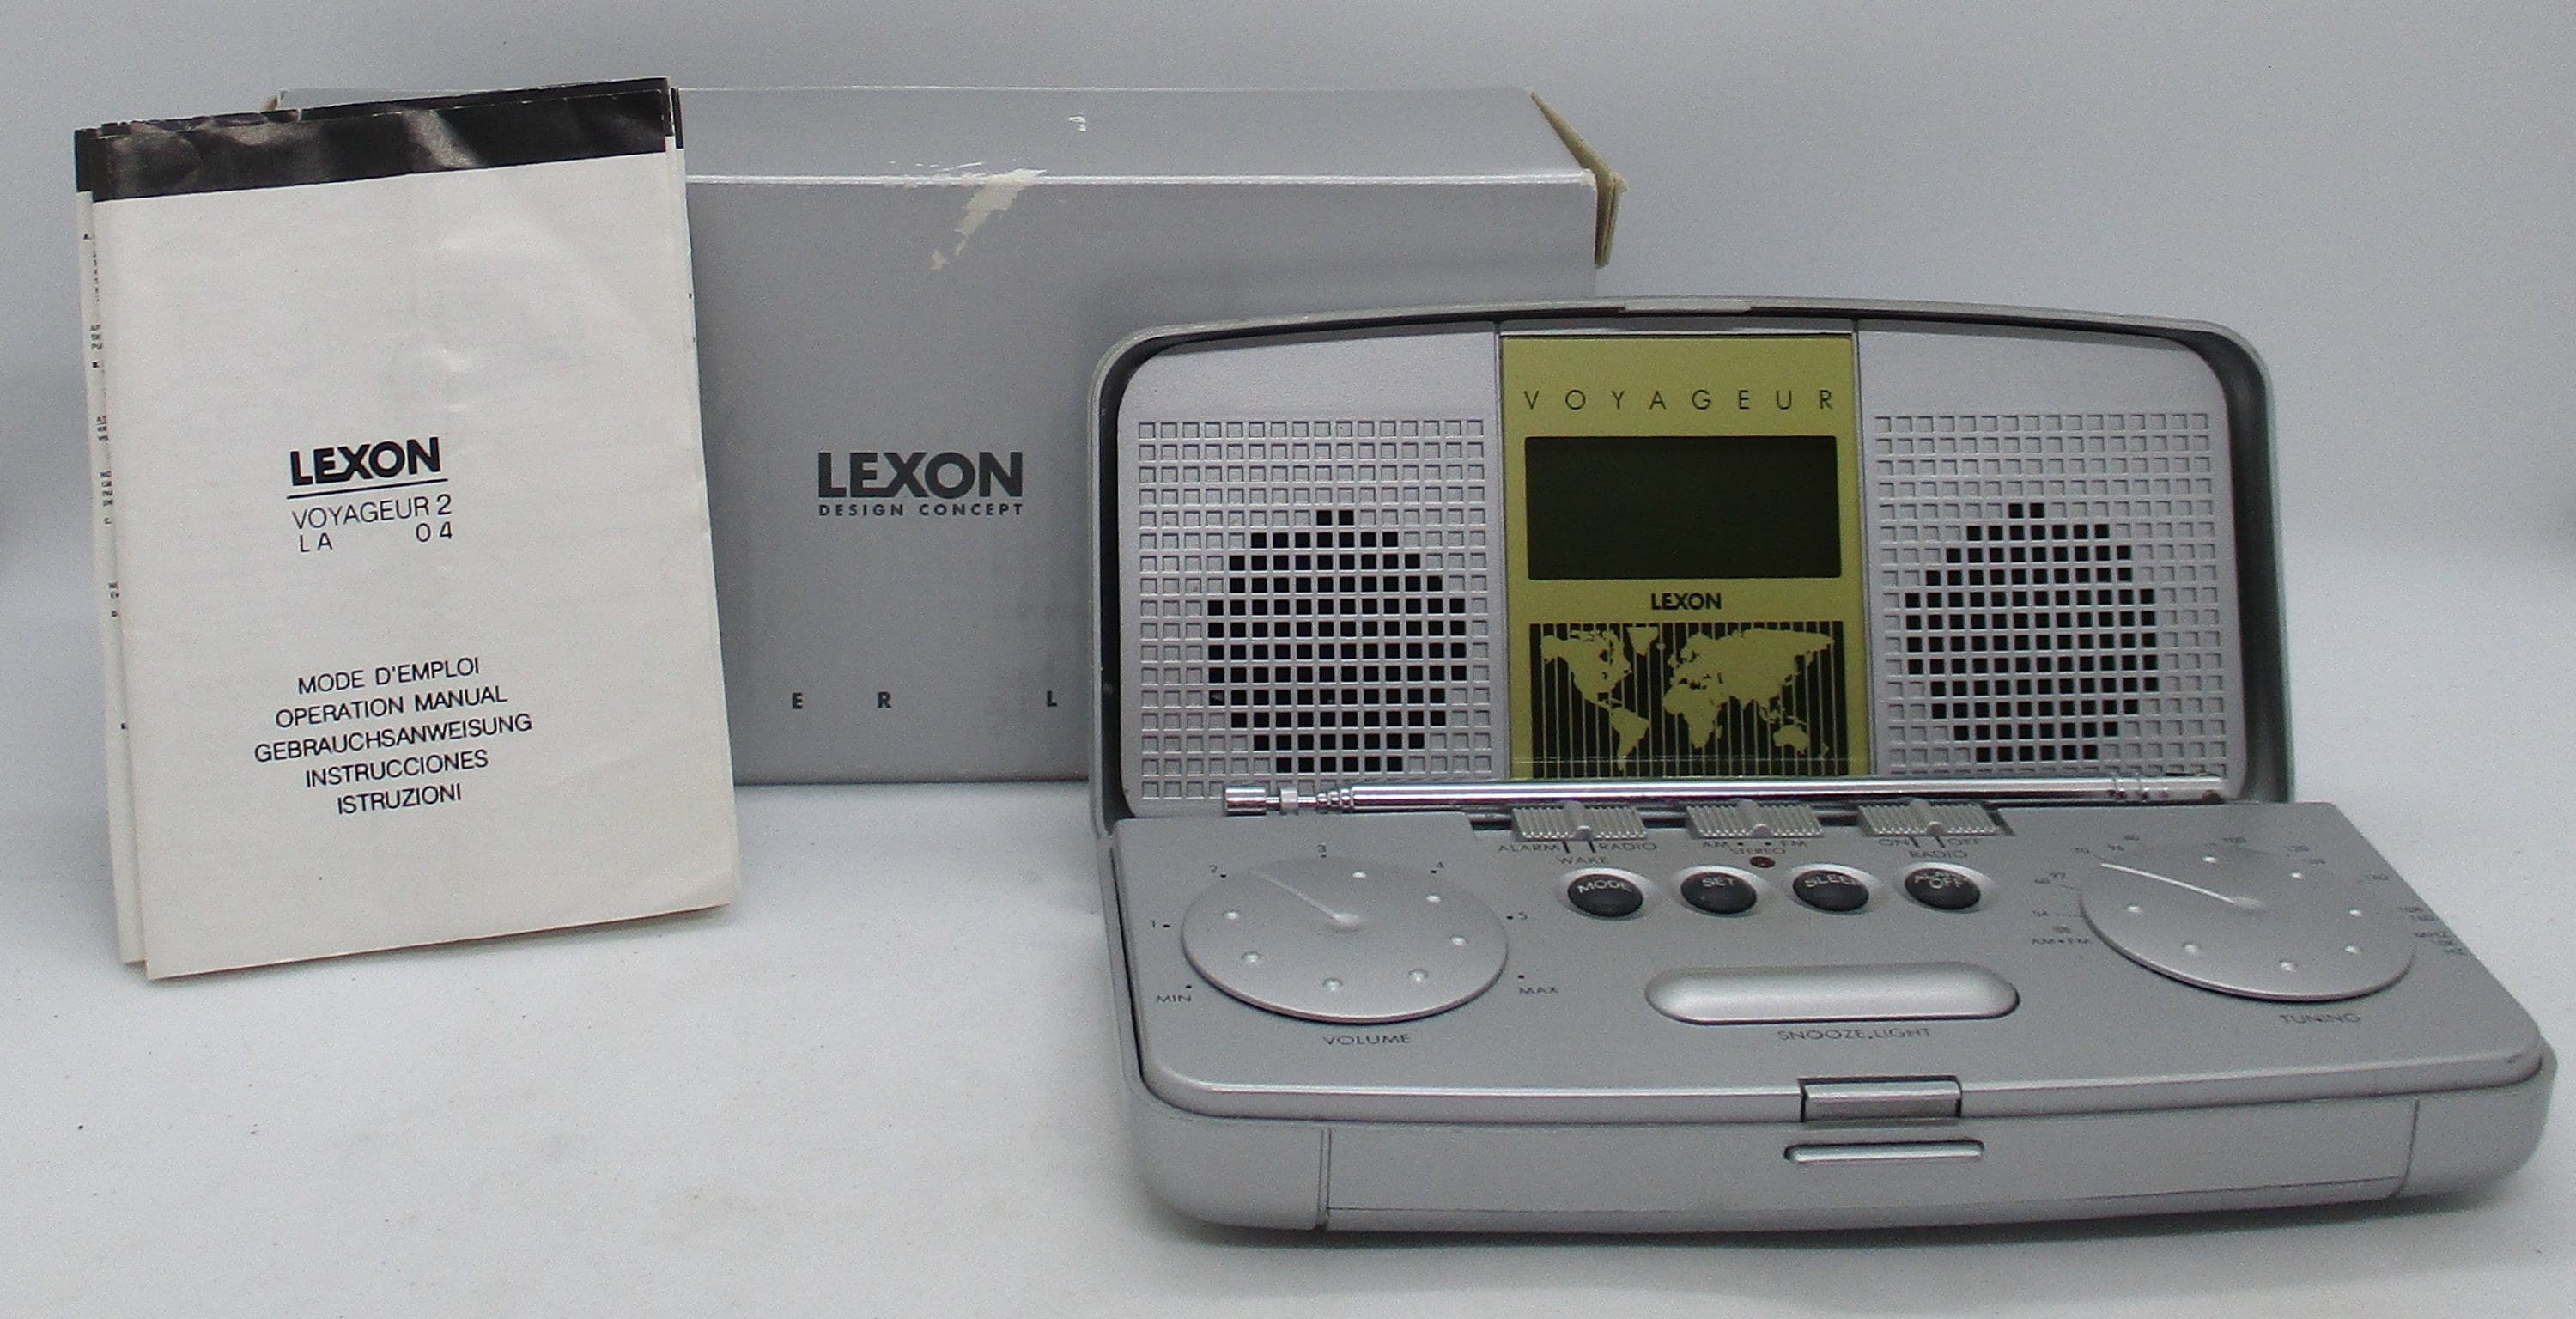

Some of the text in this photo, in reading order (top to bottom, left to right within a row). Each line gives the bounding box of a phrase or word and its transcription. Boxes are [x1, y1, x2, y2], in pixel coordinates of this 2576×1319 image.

[1522, 390, 1834, 411] VOYAGEUR
[289, 436, 441, 487] LEXON
[817, 451, 1024, 499] LEXON
[291, 493, 453, 530] VOYAGEUR 2
[818, 502, 1024, 517] DESIGN CONCEPT
[1649, 592, 1722, 611] LEXON
[297, 656, 481, 695] MODE D'EMPLOI
[275, 684, 508, 729] OPERATION MANUAL
[254, 713, 532, 763] GEBRAUCHSANWEISUNG
[305, 748, 489, 788] INSTRUCCIONES
[337, 782, 462, 816] ISTRUZIONI
[1498, 842, 1658, 854] ALARM RADIO
[1877, 837, 1910, 847] ON
[1558, 855, 1609, 865] WAKE
[1908, 849, 1969, 859] RADIO
[1701, 876, 1737, 889] SET
[1155, 994, 1192, 1004] MIN
[1518, 987, 1559, 995] MAX
[1321, 1033, 1413, 1046] VOLUME
